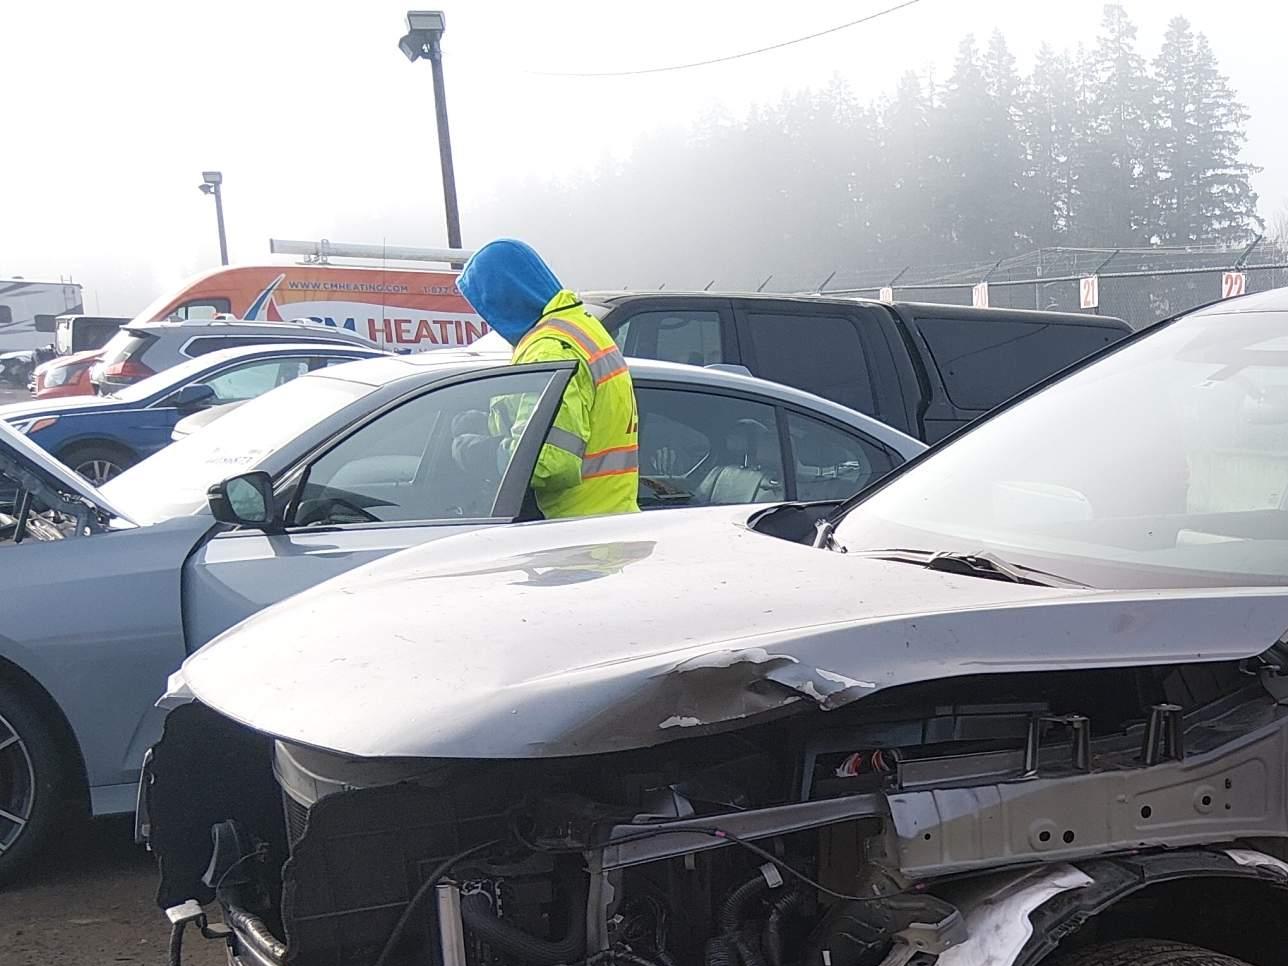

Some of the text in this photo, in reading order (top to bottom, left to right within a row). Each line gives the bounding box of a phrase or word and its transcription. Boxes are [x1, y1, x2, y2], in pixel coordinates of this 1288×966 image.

[288, 281, 408, 293] WWW.CMHEATING.COM
[1083, 279, 1095, 307] 21
[1225, 274, 1243, 298] 22
[367, 318, 493, 345] HEATIN
